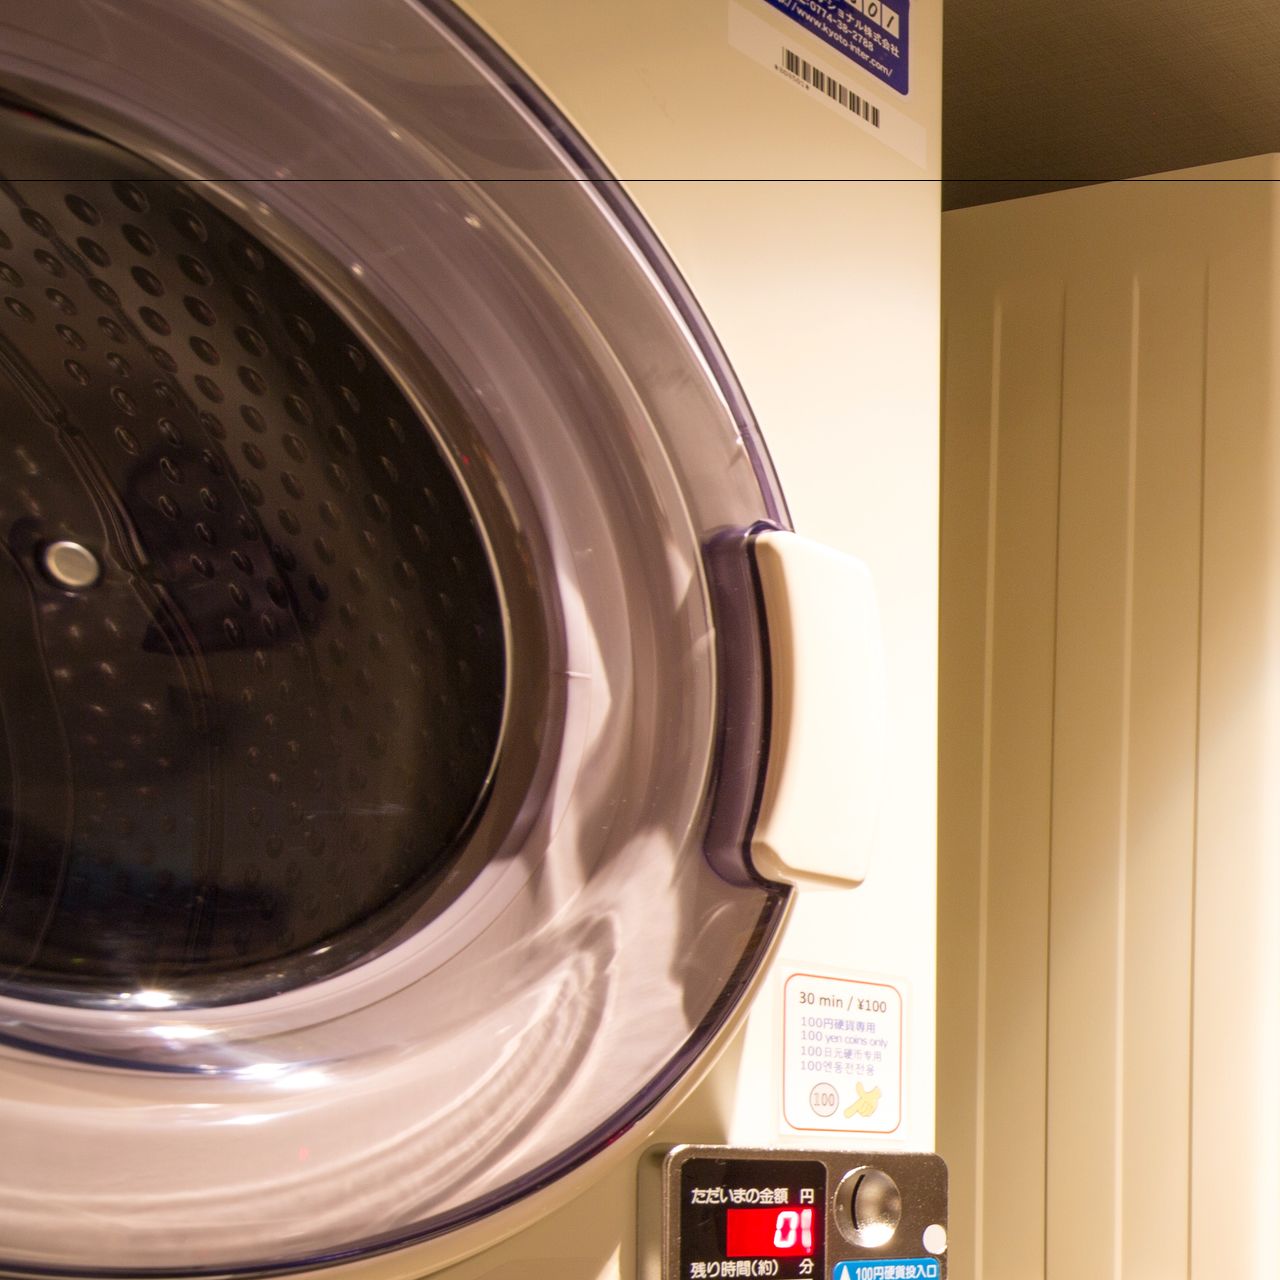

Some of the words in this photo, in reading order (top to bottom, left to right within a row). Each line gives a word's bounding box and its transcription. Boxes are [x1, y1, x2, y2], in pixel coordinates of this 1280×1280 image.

[800, 992, 814, 1005] 30
[819, 995, 843, 1008] min
[857, 999, 887, 1013] ¥100
[691, 1187, 788, 1204] ただいまの金額
[800, 1188, 814, 1204] 円
[799, 1258, 814, 1274] 分
[856, 1264, 937, 1280] 100円硬貨投入口
